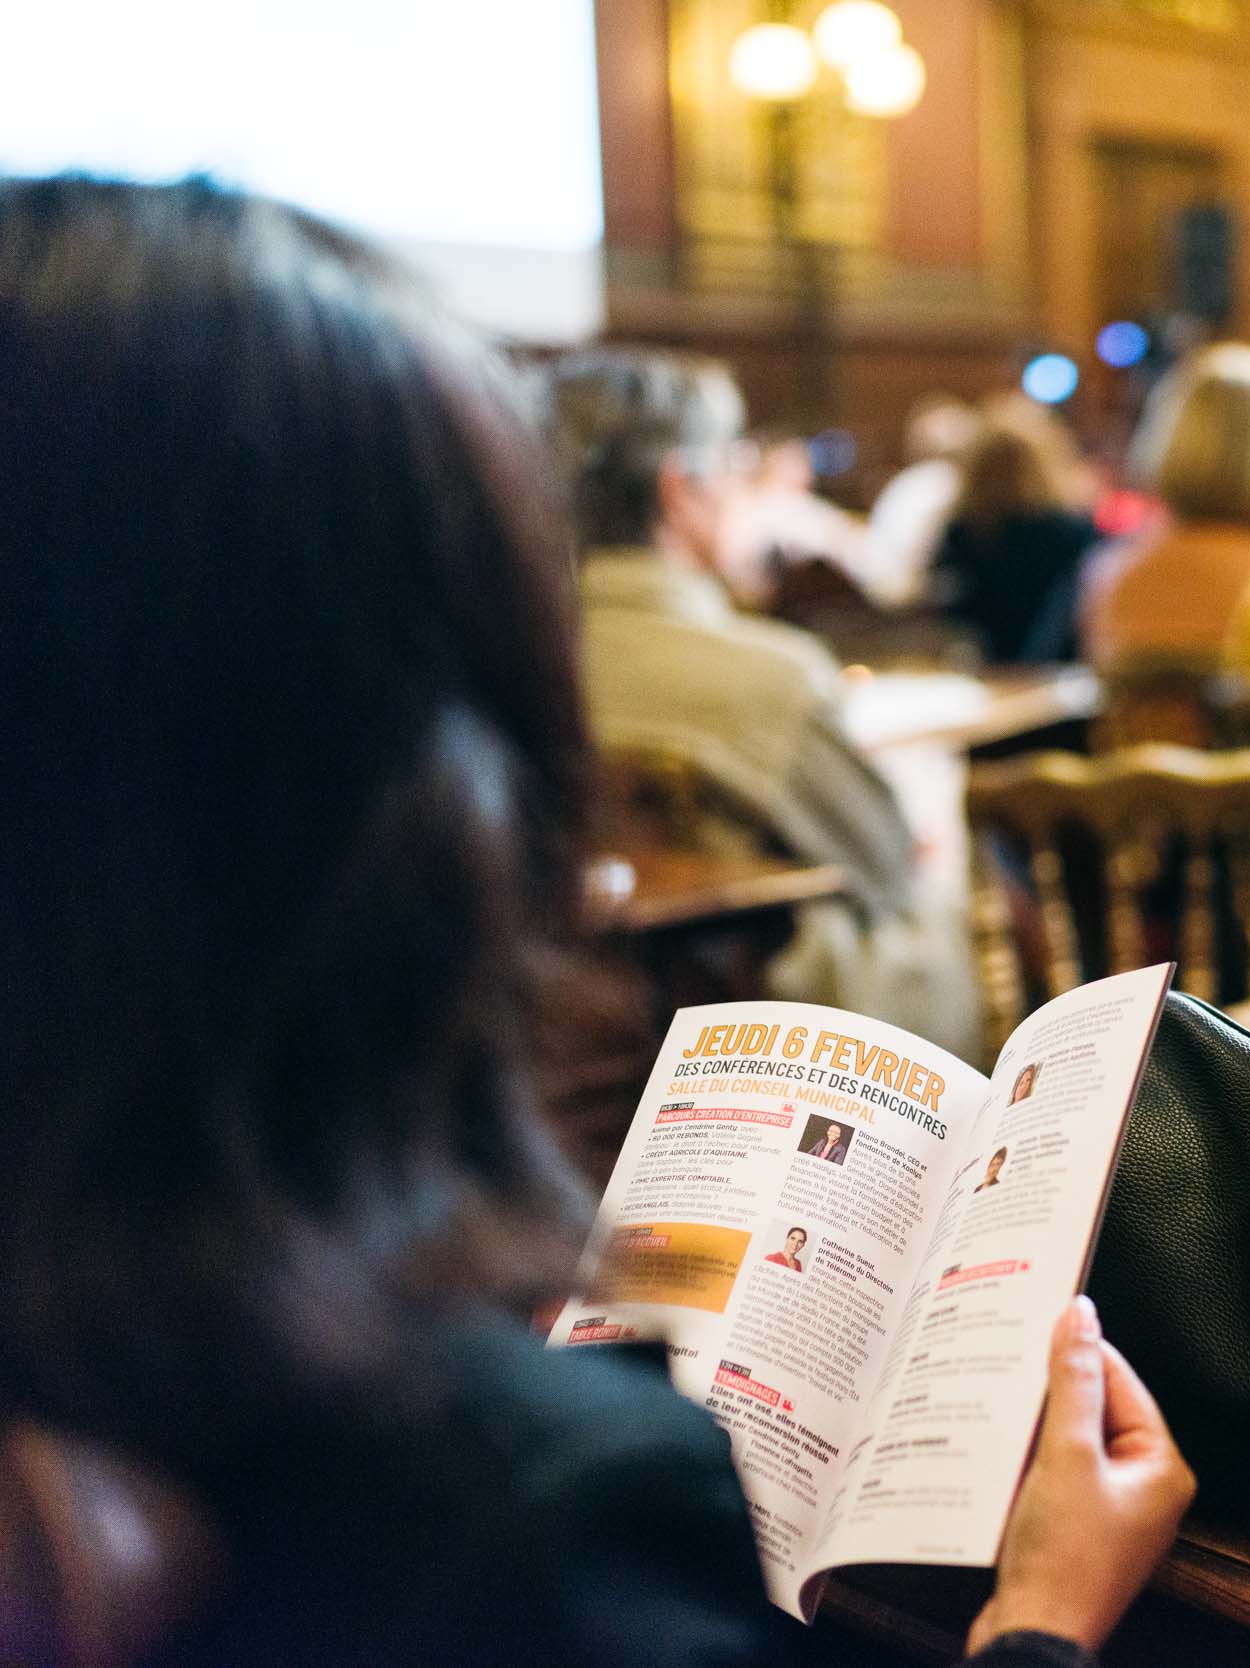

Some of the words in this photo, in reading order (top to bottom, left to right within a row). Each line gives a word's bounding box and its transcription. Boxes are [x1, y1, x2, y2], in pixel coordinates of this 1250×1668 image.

[683, 1024, 780, 1060] JEUDI
[782, 1026, 808, 1059] 6
[810, 1030, 945, 1112] FEVRIER
[658, 1110, 696, 1122] PARCOURS
[667, 1078, 706, 1096] SALLE
[708, 1078, 728, 1092] DU
[731, 1080, 793, 1099] CONSEIL
[795, 1086, 876, 1125] MUNICIPAL
[674, 1060, 698, 1077] DES
[702, 1056, 804, 1080] CONFÉRENCES
[808, 1069, 824, 1084] ET
[828, 1073, 857, 1094] DES
[860, 1085, 948, 1140] RENCONTRES
[856, 1139, 890, 1160] fondatrice
[892, 1157, 900, 1166] de
[858, 1130, 878, 1144] Diana
[921, 1164, 928, 1172] et
[815, 1256, 824, 1265] de
[827, 1260, 856, 1282] Télérama
[822, 1237, 855, 1259] Catherine
[818, 1247, 854, 1270] présidente
[856, 1266, 865, 1275] du
[865, 1271, 894, 1295] Directoire
[572, 1327, 594, 1342] TABLE
[706, 1397, 719, 1408] de
[721, 1401, 742, 1416] leur
[743, 1411, 800, 1446] reconversion
[801, 1442, 830, 1464] réussie
[710, 1384, 734, 1399] Elles
[737, 1395, 753, 1408] ont
[755, 1403, 773, 1418] osé,
[776, 1414, 796, 1429] elles
[798, 1424, 840, 1457] témoignent
